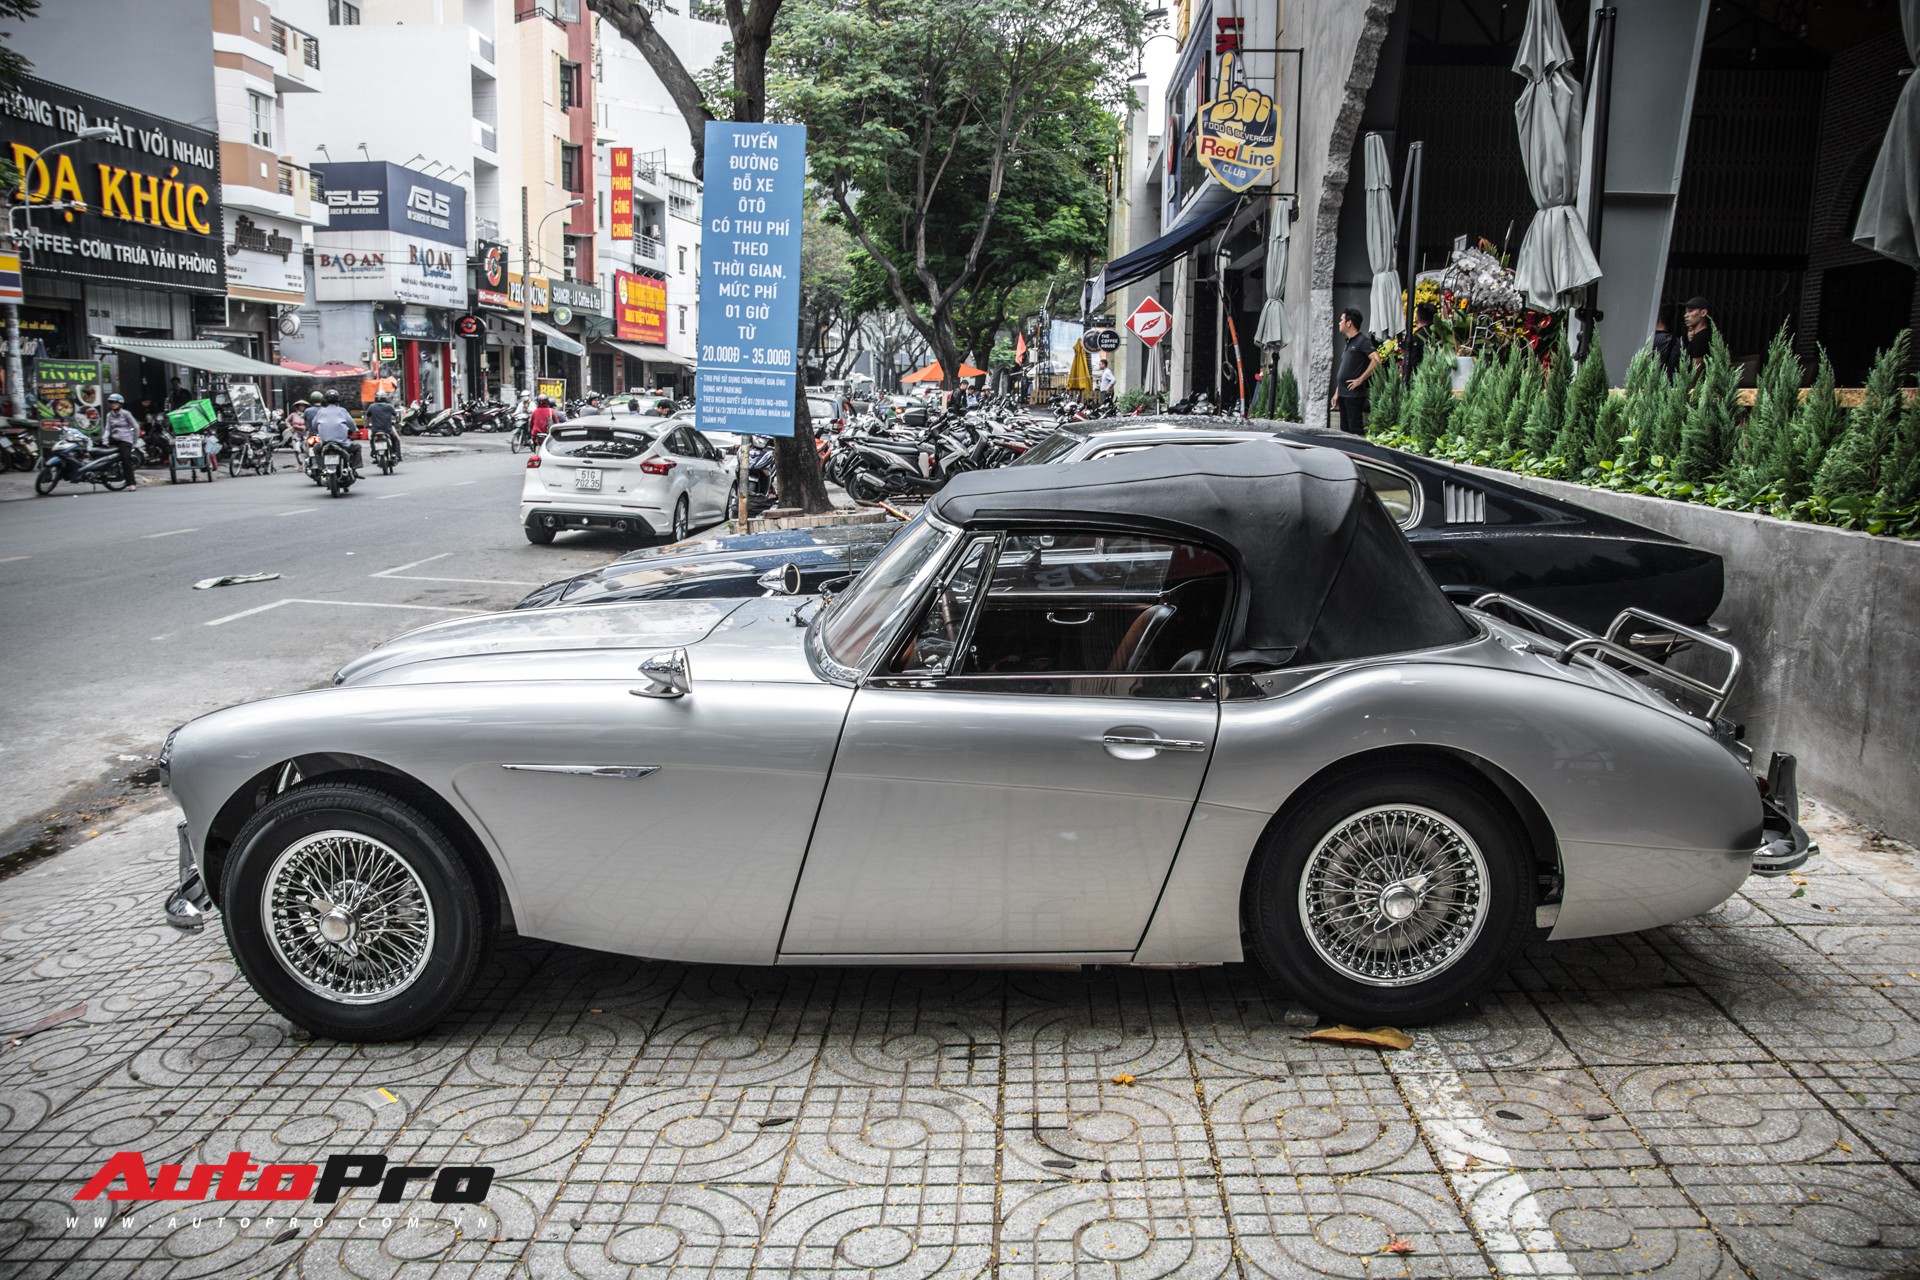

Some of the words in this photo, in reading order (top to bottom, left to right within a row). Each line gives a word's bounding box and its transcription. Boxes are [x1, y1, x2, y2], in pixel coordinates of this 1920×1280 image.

[732, 131, 778, 149] TUYẾN
[1203, 121, 1226, 134] FOOD
[1227, 127, 1233, 136] &
[1234, 130, 1274, 143] BEVERAGE
[139, 127, 169, 158] VỚI
[172, 139, 214, 170] NHAU
[729, 153, 779, 171] ĐƯỜNG
[1222, 163, 1247, 179] CLUB
[10, 141, 87, 223] DẠ
[98, 165, 210, 235] KHÚC
[732, 173, 752, 192] ĐỖ
[756, 178, 774, 192] XE
[407, 185, 451, 217] ASUS
[738, 197, 766, 213] ÔTÔ
[712, 216, 730, 233] CÓ
[734, 220, 762, 235] THU
[766, 219, 790, 236] PHÍ
[732, 241, 768, 256] THEO
[114, 243, 149, 266] TRƯA
[151, 246, 175, 269] VĂN
[178, 250, 218, 275] PHÒNG
[360, 253, 385, 267] AN
[437, 253, 452, 272] AN
[713, 260, 744, 277] THỜI
[719, 282, 750, 297] MỨC
[754, 282, 778, 299] PHÍ
[725, 304, 740, 318] 01
[746, 303, 770, 320] GIỜ
[738, 323, 757, 340] TỪ
[702, 345, 740, 363] 20.000Đ
[752, 347, 791, 366] 35.000Đ
[581, 470, 596, 479] 51G
